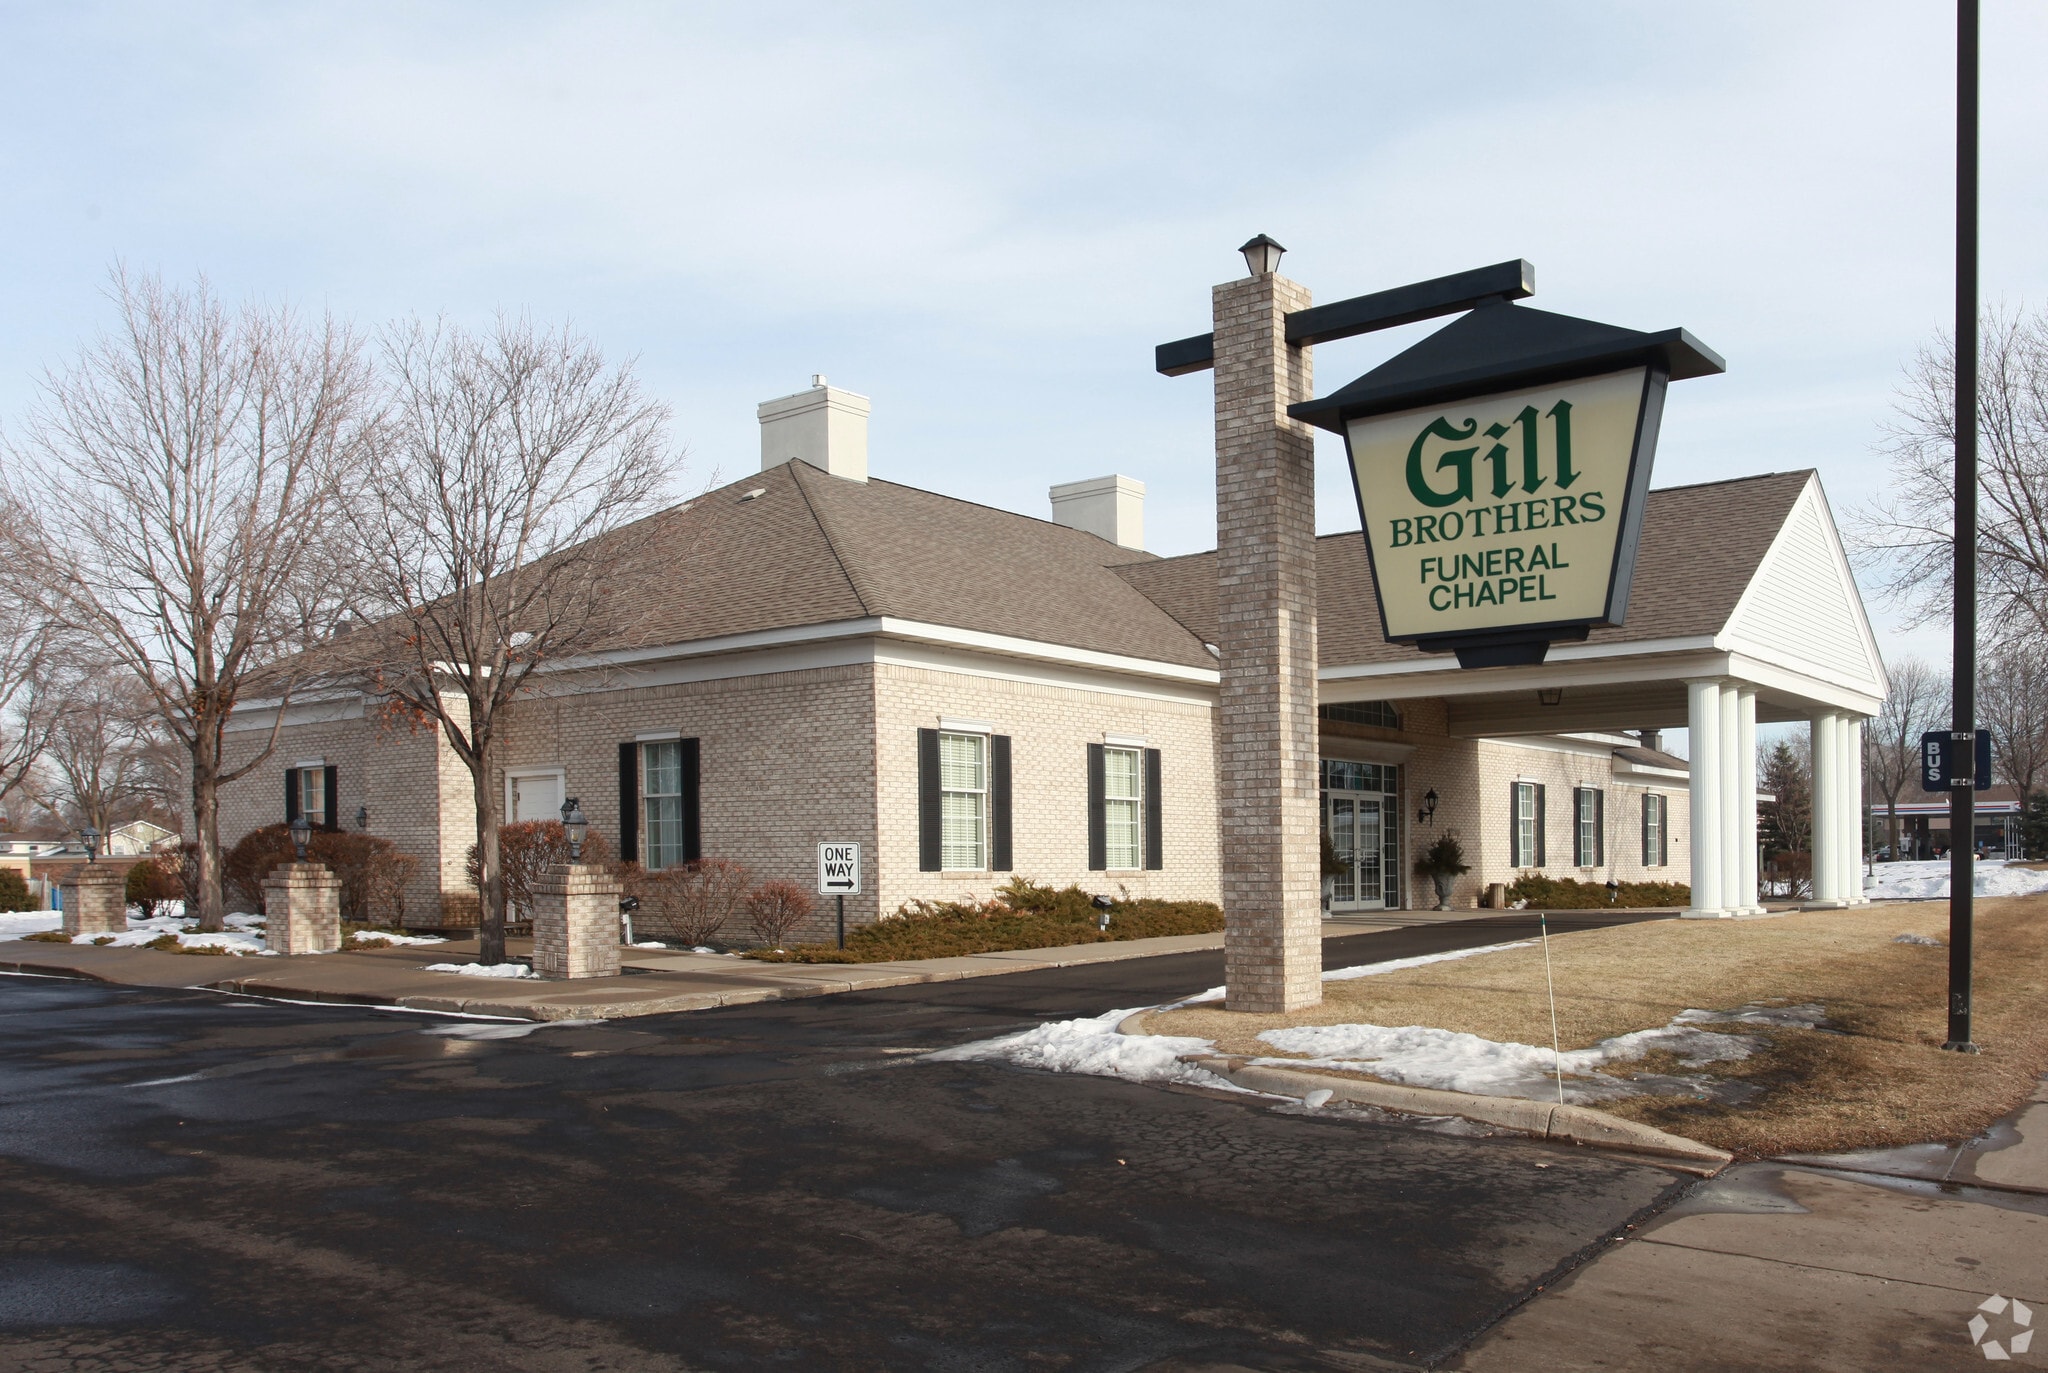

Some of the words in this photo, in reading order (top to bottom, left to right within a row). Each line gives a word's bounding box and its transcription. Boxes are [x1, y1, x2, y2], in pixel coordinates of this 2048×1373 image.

[1406, 399, 1582, 508] Gill
[1389, 491, 1606, 548] BROTHERS
[1420, 543, 1569, 584] FUNERAL
[1429, 574, 1556, 612] CHAPEL
[1927, 742, 1941, 782] BUS
[825, 847, 853, 861] ONE
[825, 863, 854, 877] WAY
